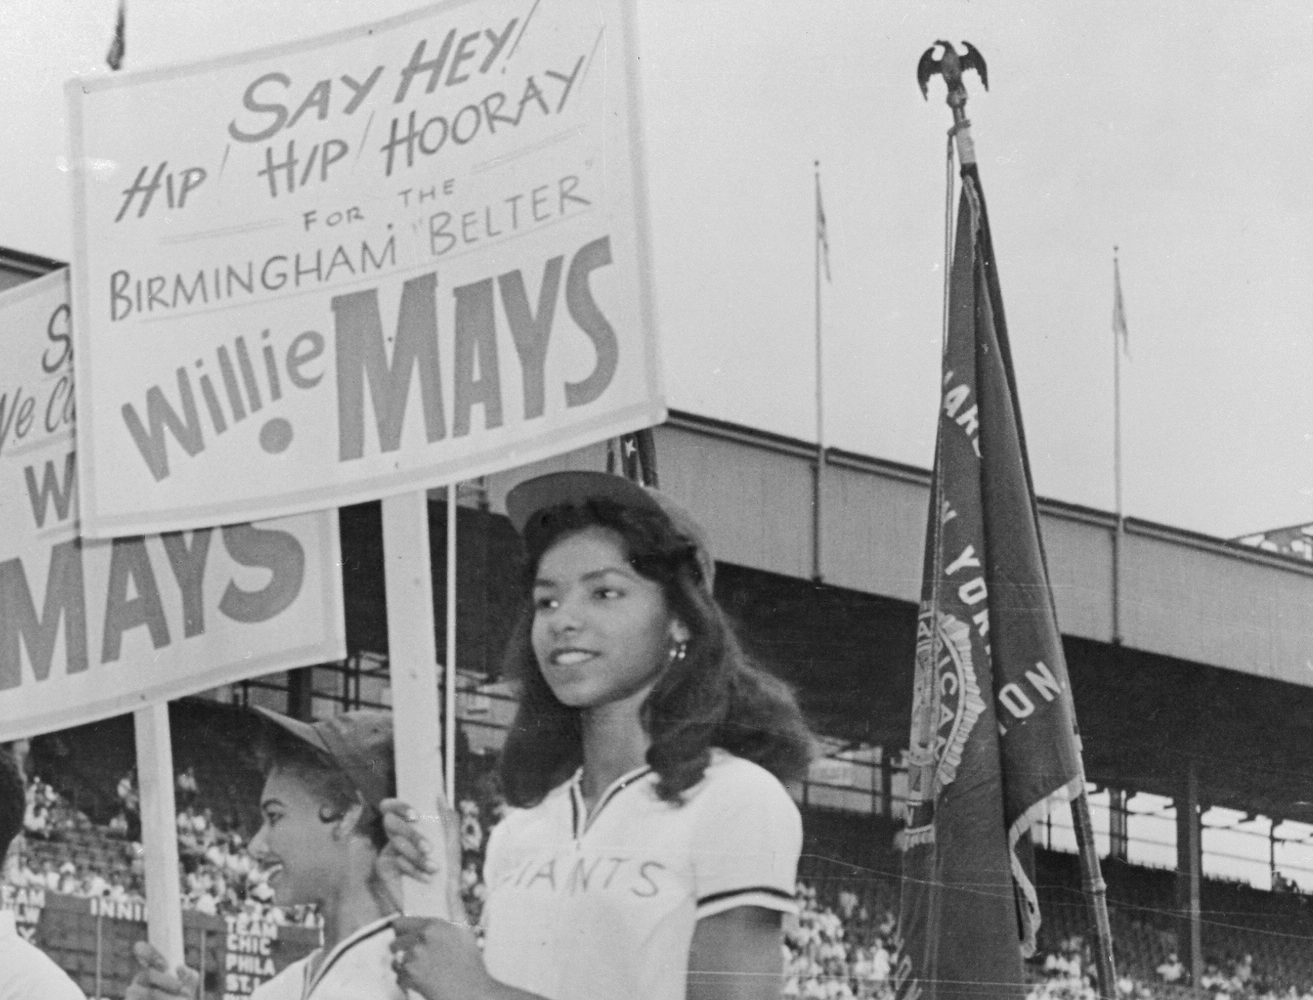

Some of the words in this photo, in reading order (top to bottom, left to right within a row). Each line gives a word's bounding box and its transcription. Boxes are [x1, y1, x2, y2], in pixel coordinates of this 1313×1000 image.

[228, 64, 385, 144] SAY
[393, 1, 540, 104] HEY!
[303, 206, 366, 231] FOR
[397, 177, 457, 207] THE
[109, 233, 397, 322] BIRMINGHAM
[121, 328, 326, 483] Willie
[331, 235, 619, 463] MAYS
